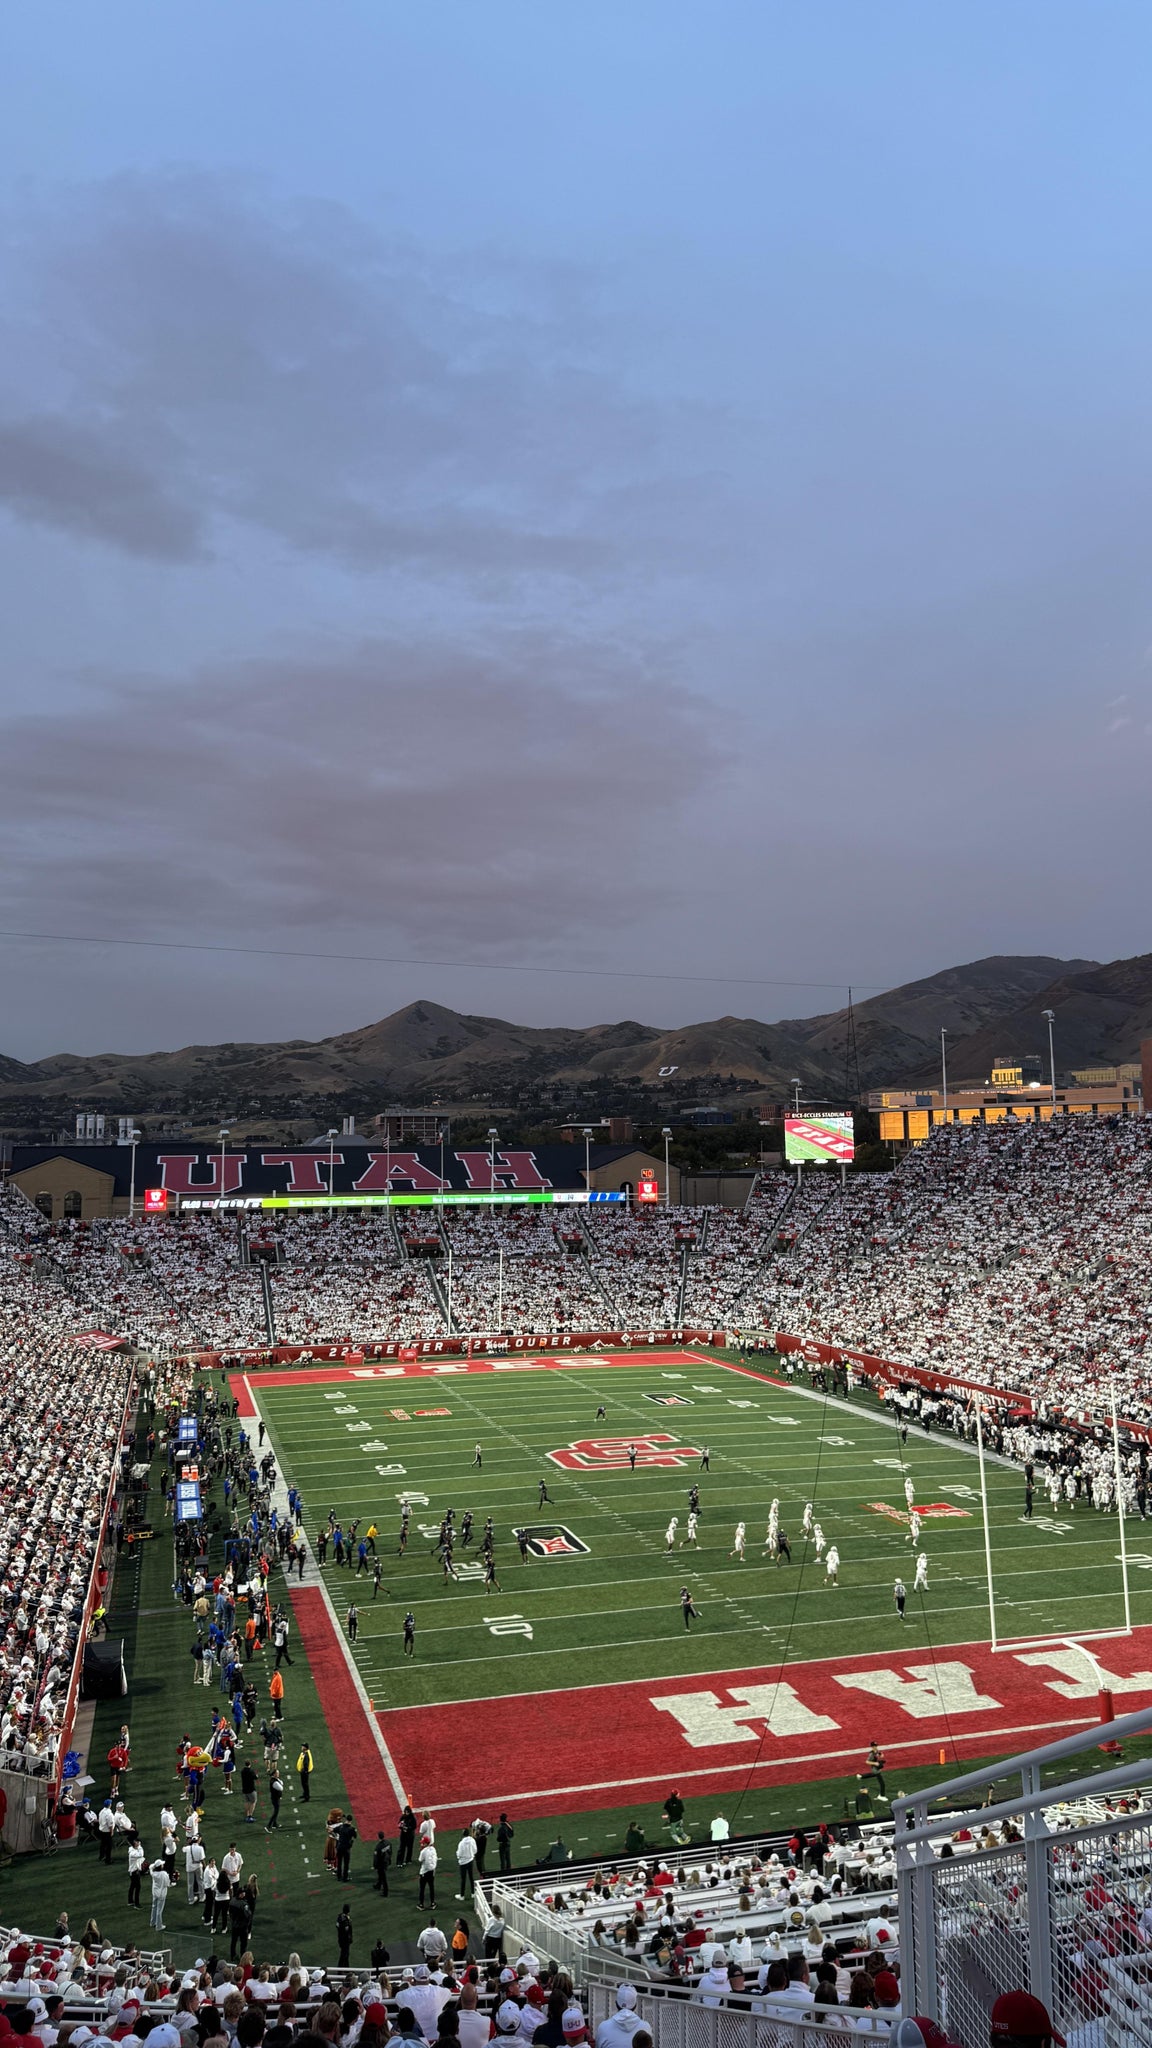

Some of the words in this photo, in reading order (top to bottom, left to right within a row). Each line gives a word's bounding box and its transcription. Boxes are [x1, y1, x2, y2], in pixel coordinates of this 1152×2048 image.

[658, 1066, 679, 1077] U
[157, 1152, 552, 1194] UTAH
[349, 1357, 611, 1378] UTES
[375, 1463, 407, 1476] 50
[1017, 1516, 1075, 1531] 20
[483, 1614, 533, 1636] 10
[649, 1649, 1152, 1748] TAH
